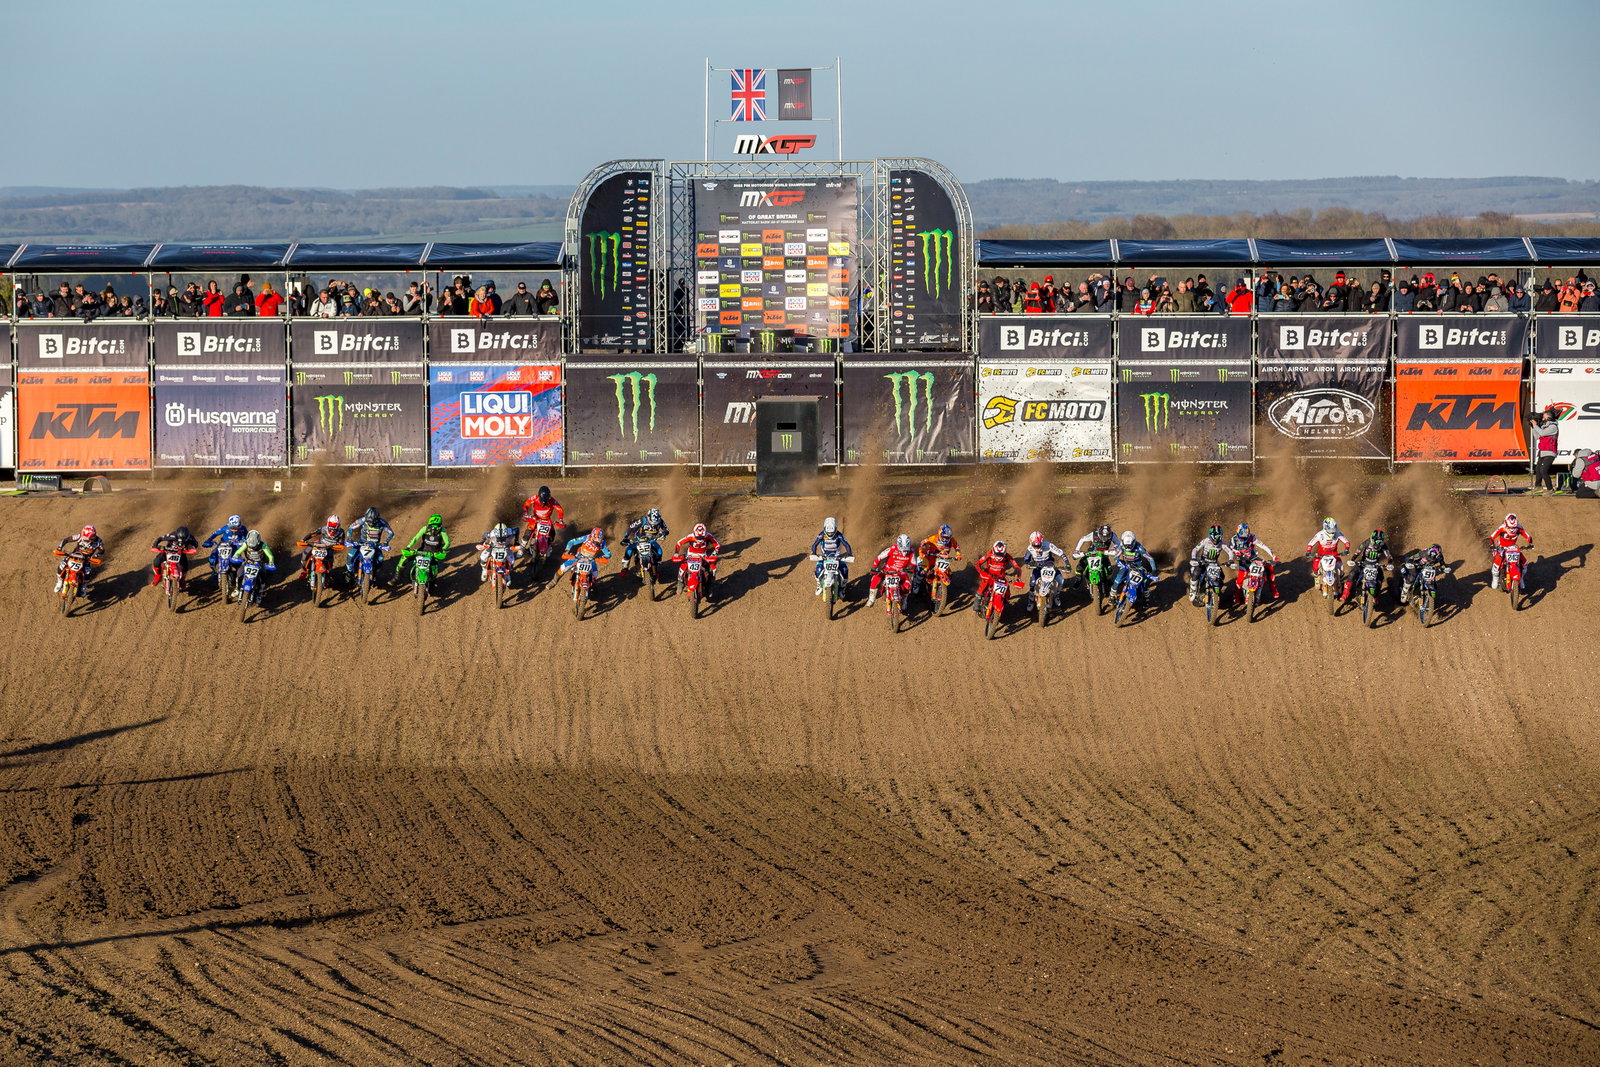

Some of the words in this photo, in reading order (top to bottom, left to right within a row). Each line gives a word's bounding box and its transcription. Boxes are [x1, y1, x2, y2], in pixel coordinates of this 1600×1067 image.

[733, 135, 817, 155] MXGP
[739, 190, 807, 208] MXGP
[1399, 367, 1422, 375] KTM
[1434, 367, 1458, 375] KTM
[1468, 367, 1492, 375] KTM
[21, 376, 44, 384] KTM
[55, 376, 78, 384] KTM
[89, 375, 112, 384] KTM
[122, 375, 146, 384] KTM
[344, 402, 402, 413] MONSTER
[464, 394, 528, 415] LIQUI
[1170, 399, 1229, 410] MONSTER
[1280, 397, 1365, 424] Airoh
[1406, 394, 1516, 430] KTM
[28, 403, 141, 439] KTM
[187, 408, 277, 427] Husqvarna
[464, 416, 530, 436] MOLY
[1468, 449, 1492, 457] KTM
[70, 562, 81, 570] 75
[578, 563, 591, 571] 911
[689, 563, 699, 571] 43
[1090, 559, 1100, 568] 14
[244, 567, 258, 576] 92
[1130, 574, 1141, 583] 10
